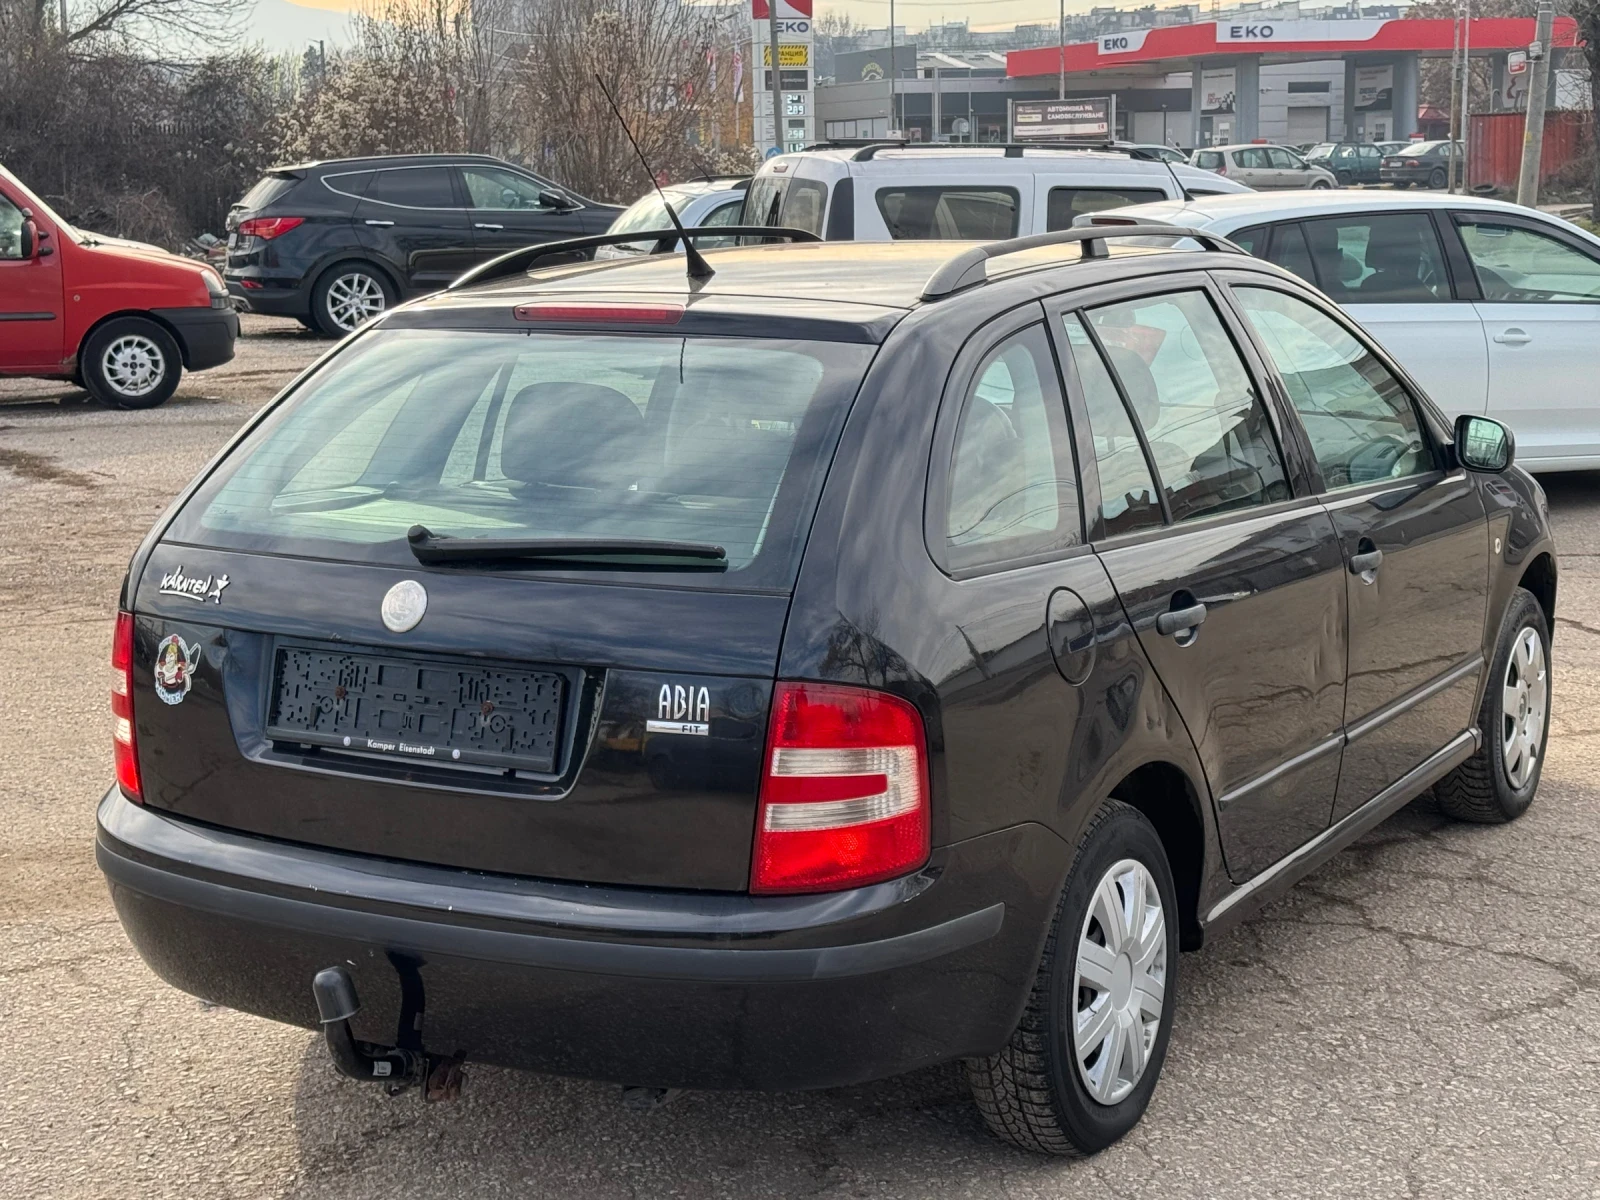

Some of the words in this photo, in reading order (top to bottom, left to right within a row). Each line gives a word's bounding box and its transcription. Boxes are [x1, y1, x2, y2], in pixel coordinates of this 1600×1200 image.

[776, 21, 809, 33] EKO
[1230, 25, 1274, 38] EKO
[1104, 37, 1128, 50] EKO
[658, 684, 710, 722] ABIA
[681, 725, 701, 733] FIT
[367, 739, 396, 751] Kamper
[399, 743, 435, 755] Eisenstadt
